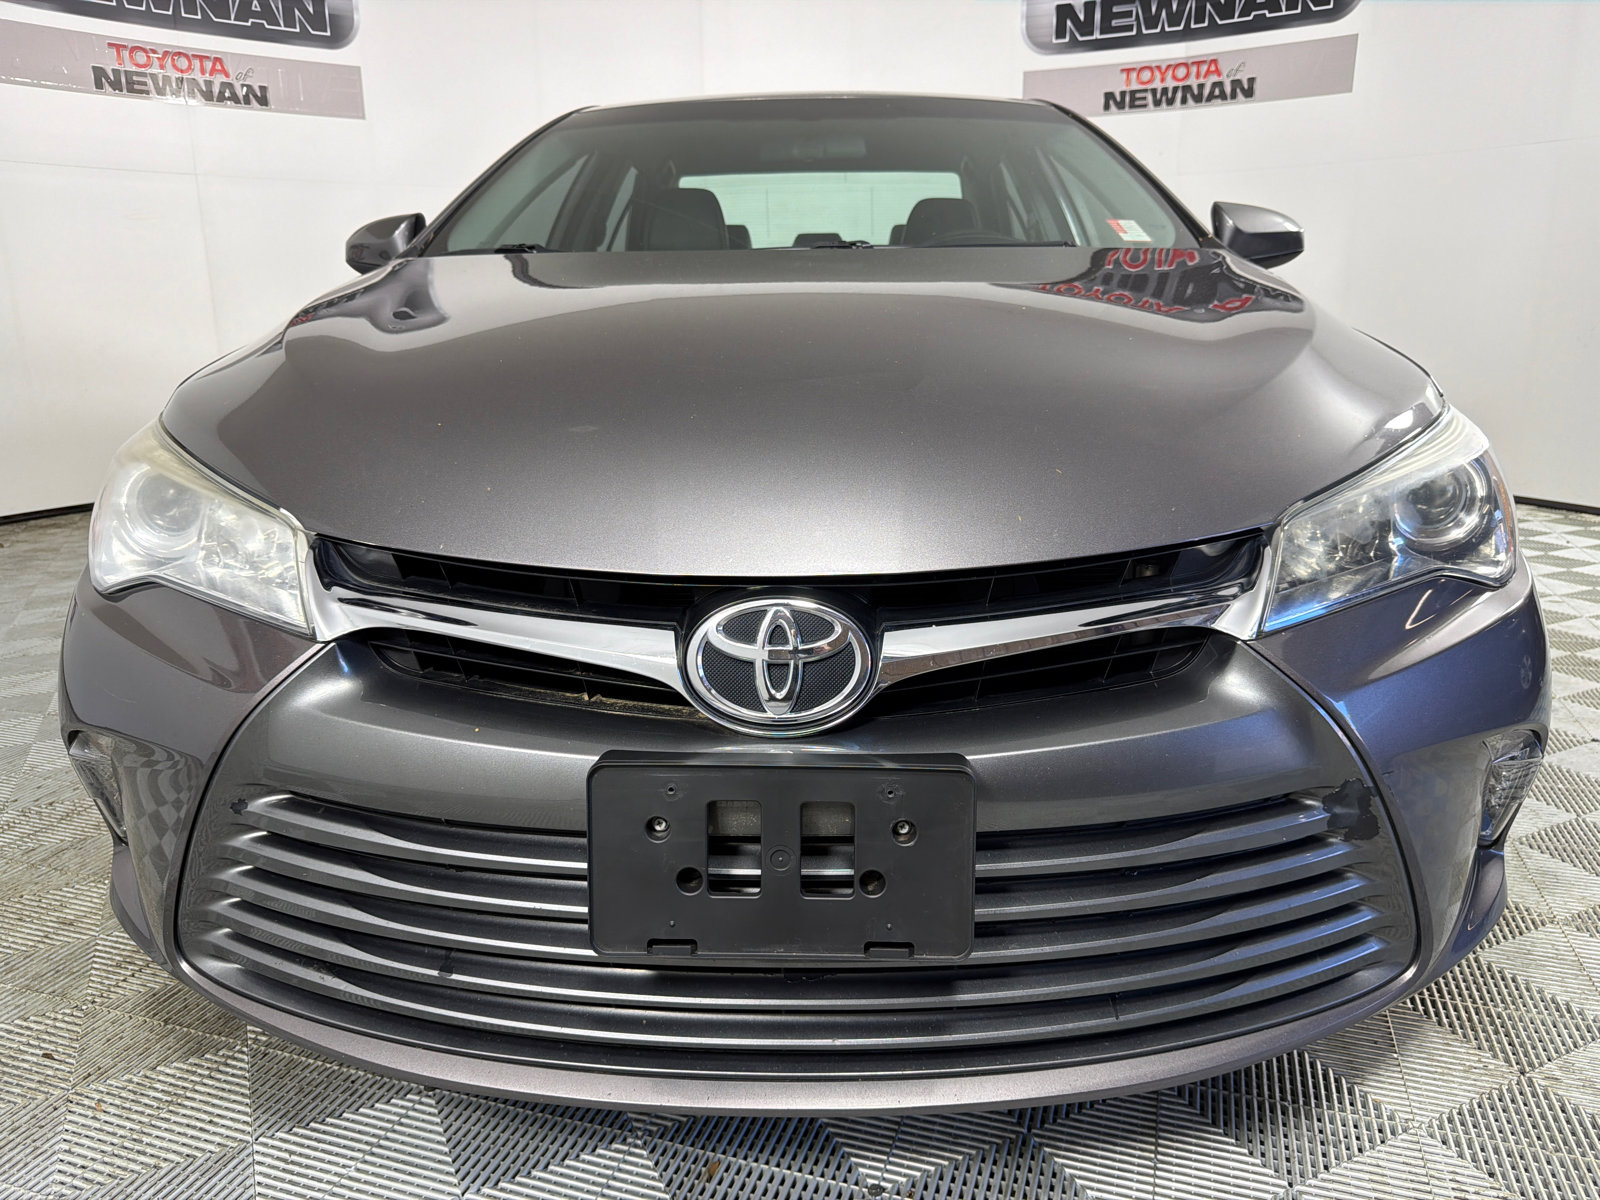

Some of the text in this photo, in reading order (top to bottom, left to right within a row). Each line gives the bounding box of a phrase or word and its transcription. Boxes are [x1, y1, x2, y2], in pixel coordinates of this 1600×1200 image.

[1052, 0, 1334, 43] NEWNA
[107, 42, 254, 82] TOYOTA of
[1120, 58, 1246, 88] TOYOTA of
[91, 65, 270, 107] NEWNAN
[1103, 77, 1256, 111] NEWNAN
